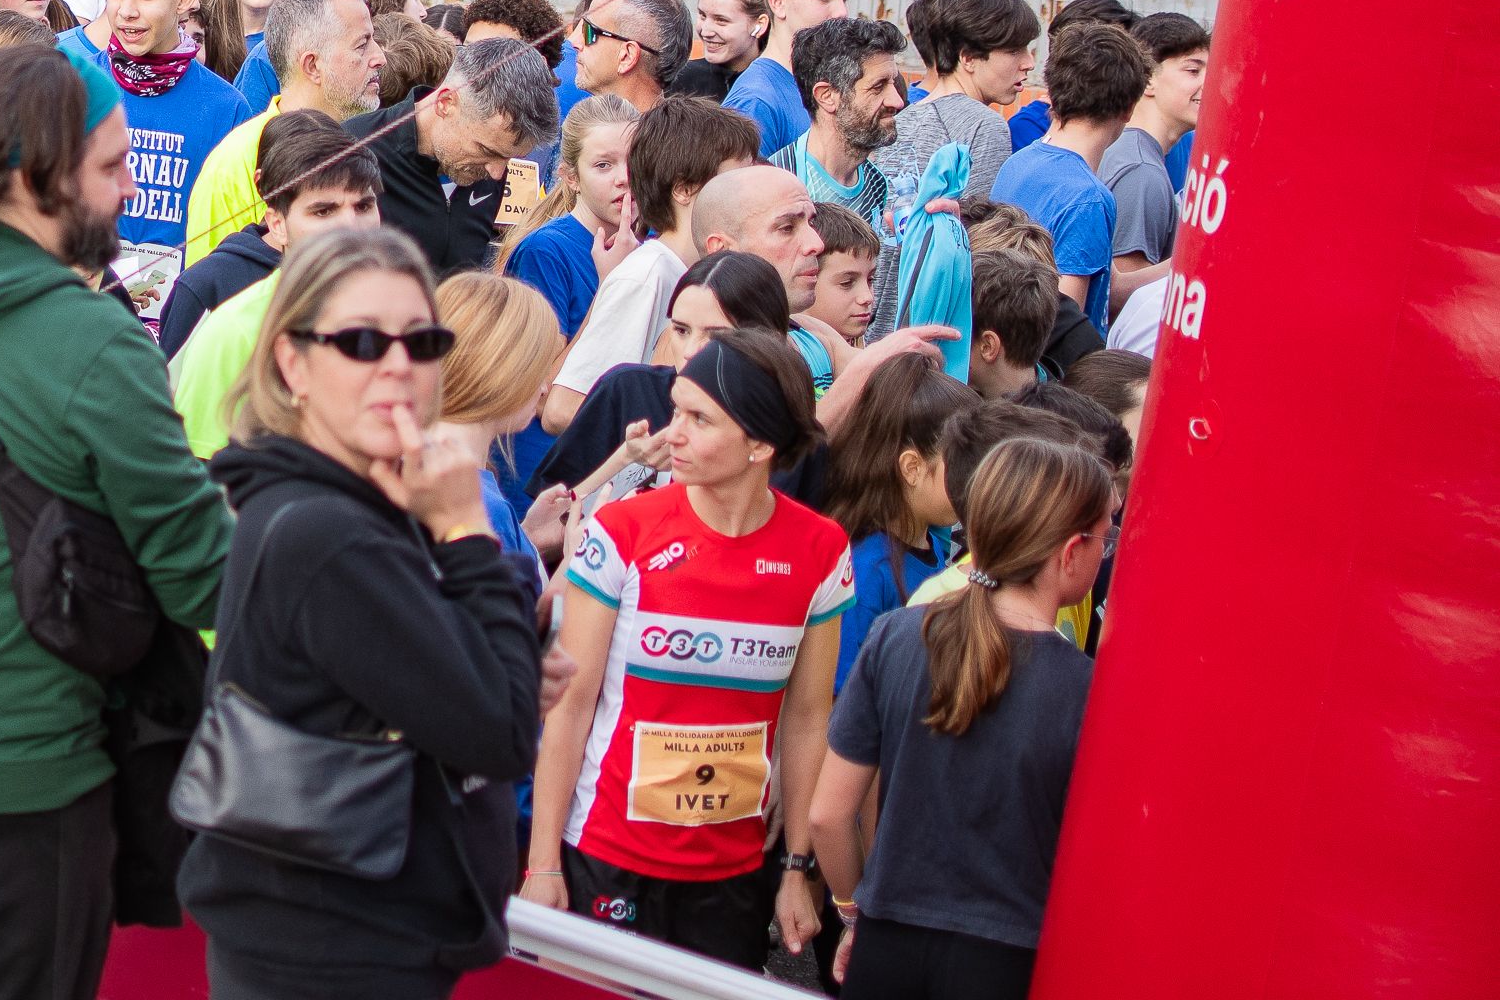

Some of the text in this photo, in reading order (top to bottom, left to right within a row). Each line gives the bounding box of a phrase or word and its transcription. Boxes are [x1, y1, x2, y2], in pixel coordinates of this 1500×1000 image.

[730, 637, 797, 658] T3Team
[664, 741, 745, 753] MILLA ADULTS
[695, 764, 715, 785] 9
[675, 794, 730, 811] IVET
